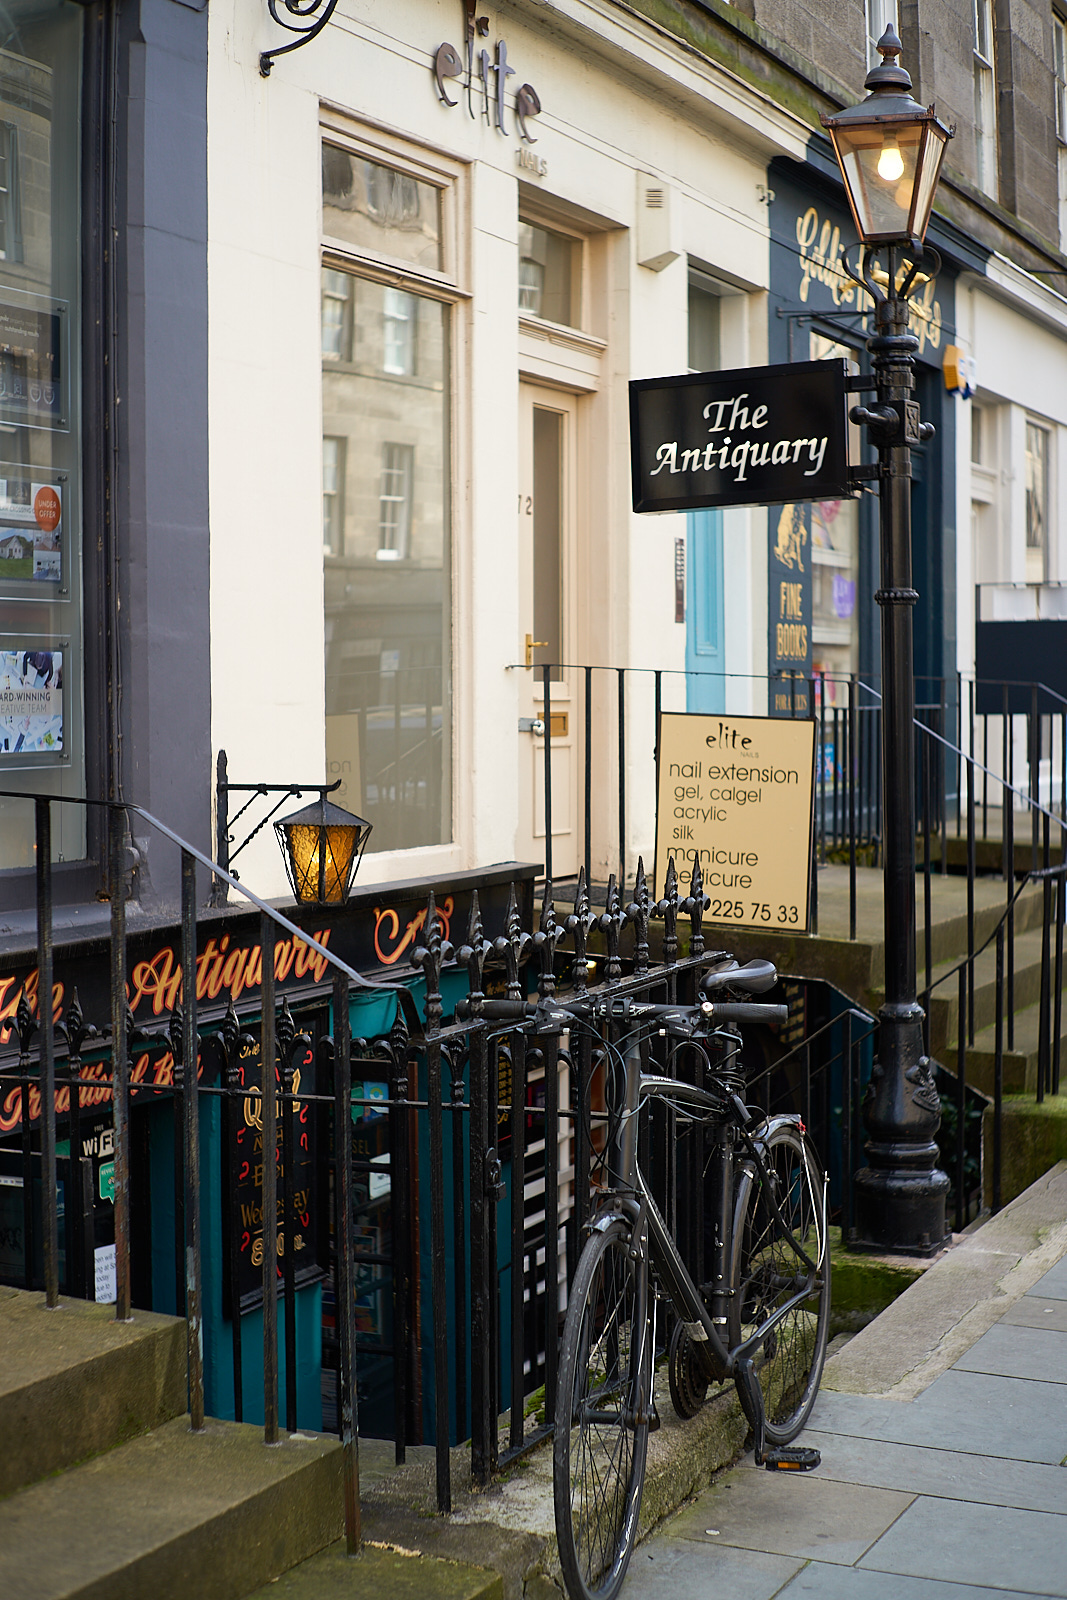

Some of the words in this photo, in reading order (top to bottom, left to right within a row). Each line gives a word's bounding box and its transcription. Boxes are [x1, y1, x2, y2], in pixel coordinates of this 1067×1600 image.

[436, 0, 541, 144] elite
[702, 393, 769, 433] The
[649, 436, 828, 482] Antiquary
[39, 500, 57, 509] UNDER
[39, 510, 56, 519] OFFER
[780, 581, 803, 620] FINE
[776, 622, 808, 661] BOOKS
[28, 703, 47, 713] TEAM
[705, 722, 753, 750] elite
[740, 751, 760, 759] NAILS
[669, 761, 702, 779] nail
[708, 764, 799, 785] extension
[674, 785, 704, 802] gel,
[710, 787, 762, 806] calgel
[673, 806, 727, 824] acrylic
[672, 825, 695, 841] silk
[666, 846, 759, 867] manicure
[711, 899, 744, 919] 225
[751, 903, 771, 921] 75
[777, 905, 799, 923] 33
